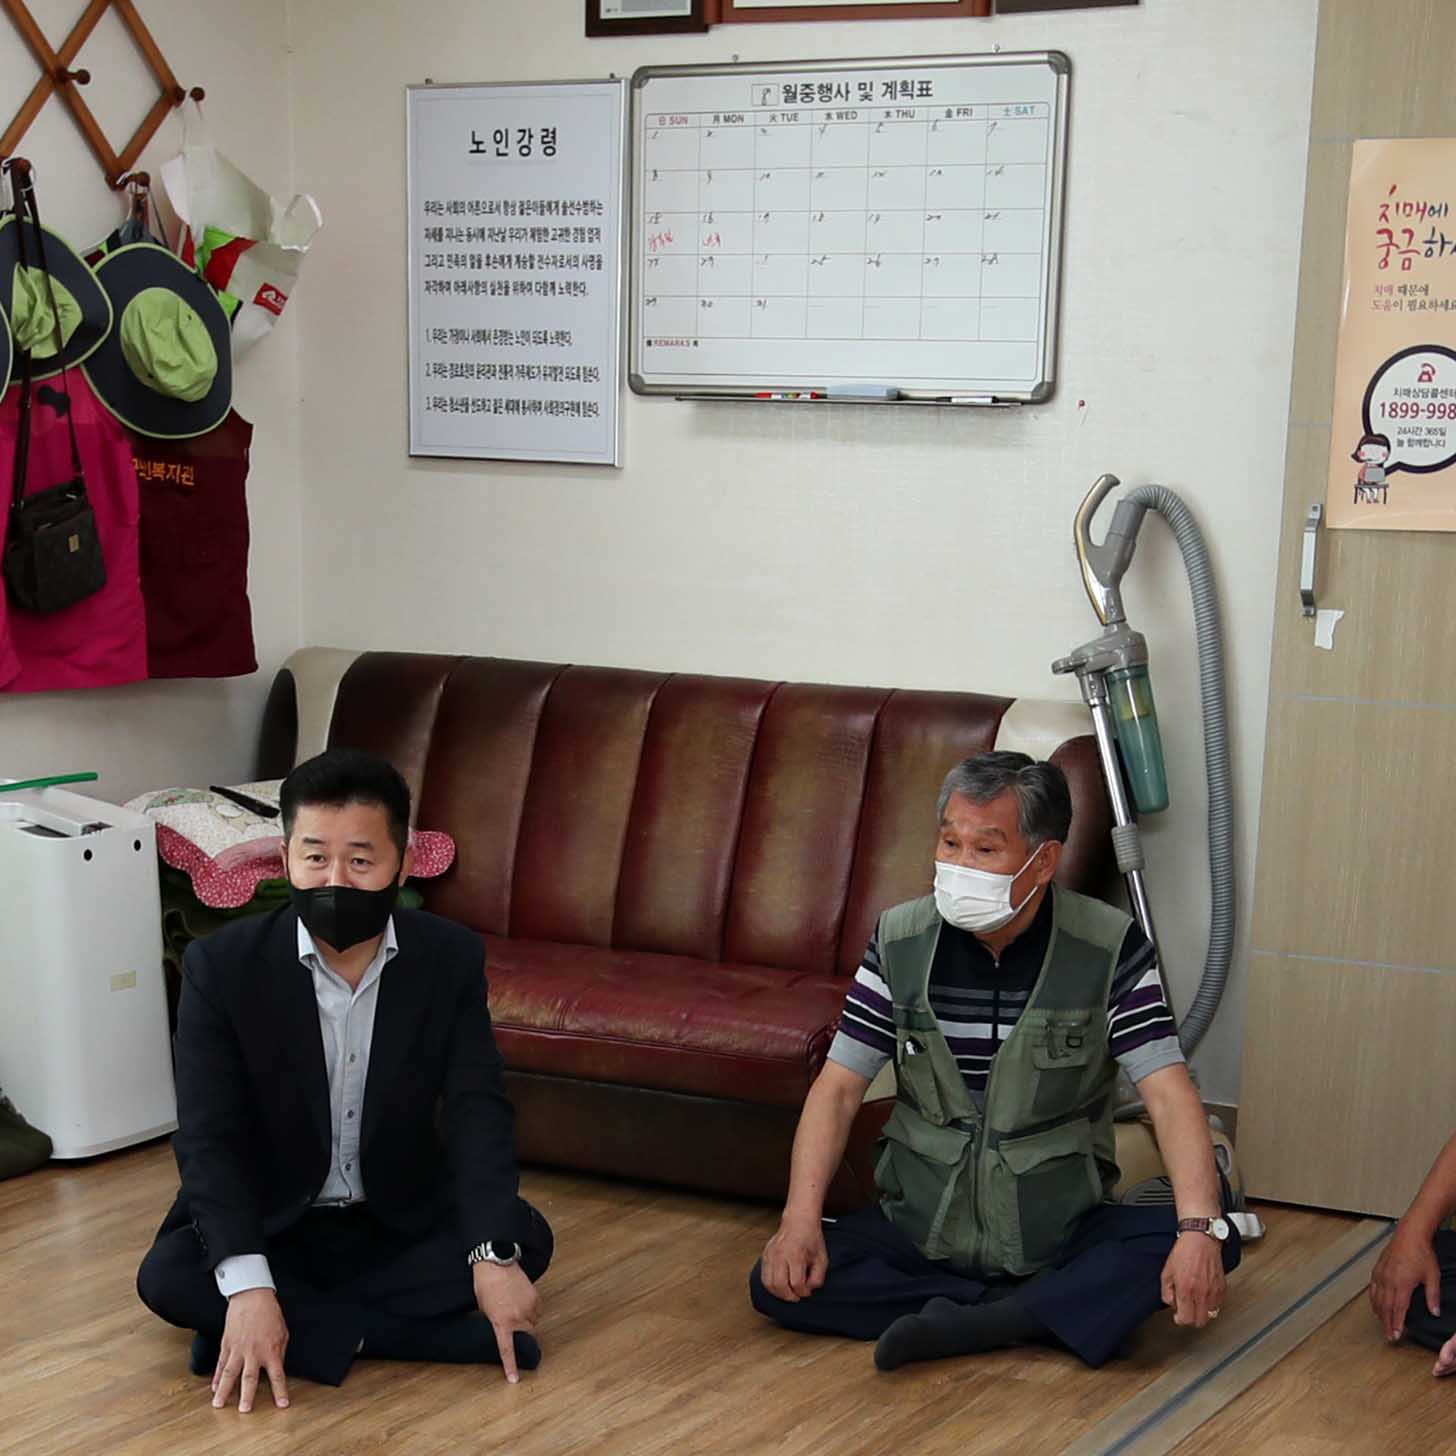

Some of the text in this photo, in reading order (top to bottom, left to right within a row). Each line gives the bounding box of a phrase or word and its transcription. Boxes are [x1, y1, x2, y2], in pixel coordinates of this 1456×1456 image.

[782, 79, 934, 104] 월중행사 및 계획표
[836, 110, 858, 121] WED
[896, 109, 916, 119] THU
[956, 108, 973, 118] FRI
[1013, 105, 1035, 116] SAT
[669, 116, 689, 125] SUN
[723, 113, 744, 124] MON
[780, 112, 799, 122] TUE
[424, 201, 443, 215] 우리는
[446, 201, 465, 215] 사회의
[467, 201, 501, 215] 어른으로서
[503, 201, 516, 215] 항상
[561, 201, 603, 215] 솔선수범하는
[1378, 184, 1449, 224] 치매에
[445, 227, 464, 243] 지니는
[466, 227, 485, 243] 동시에
[487, 227, 506, 243] 지난날
[508, 227, 528, 243] 우리가
[572, 227, 585, 243] 경험
[424, 254, 444, 269] 그리고
[447, 254, 467, 269] 민족의
[484, 254, 512, 269] 후손에게
[537, 254, 579, 270] 전수자로서의
[581, 254, 602, 270] 사명을
[512, 281, 533, 296] 위하여
[535, 281, 555, 296] 다함께
[1375, 284, 1429, 297] 치매 때문에
[1372, 299, 1403, 311] 도움이
[1397, 426, 1447, 437] 24시간 365일
